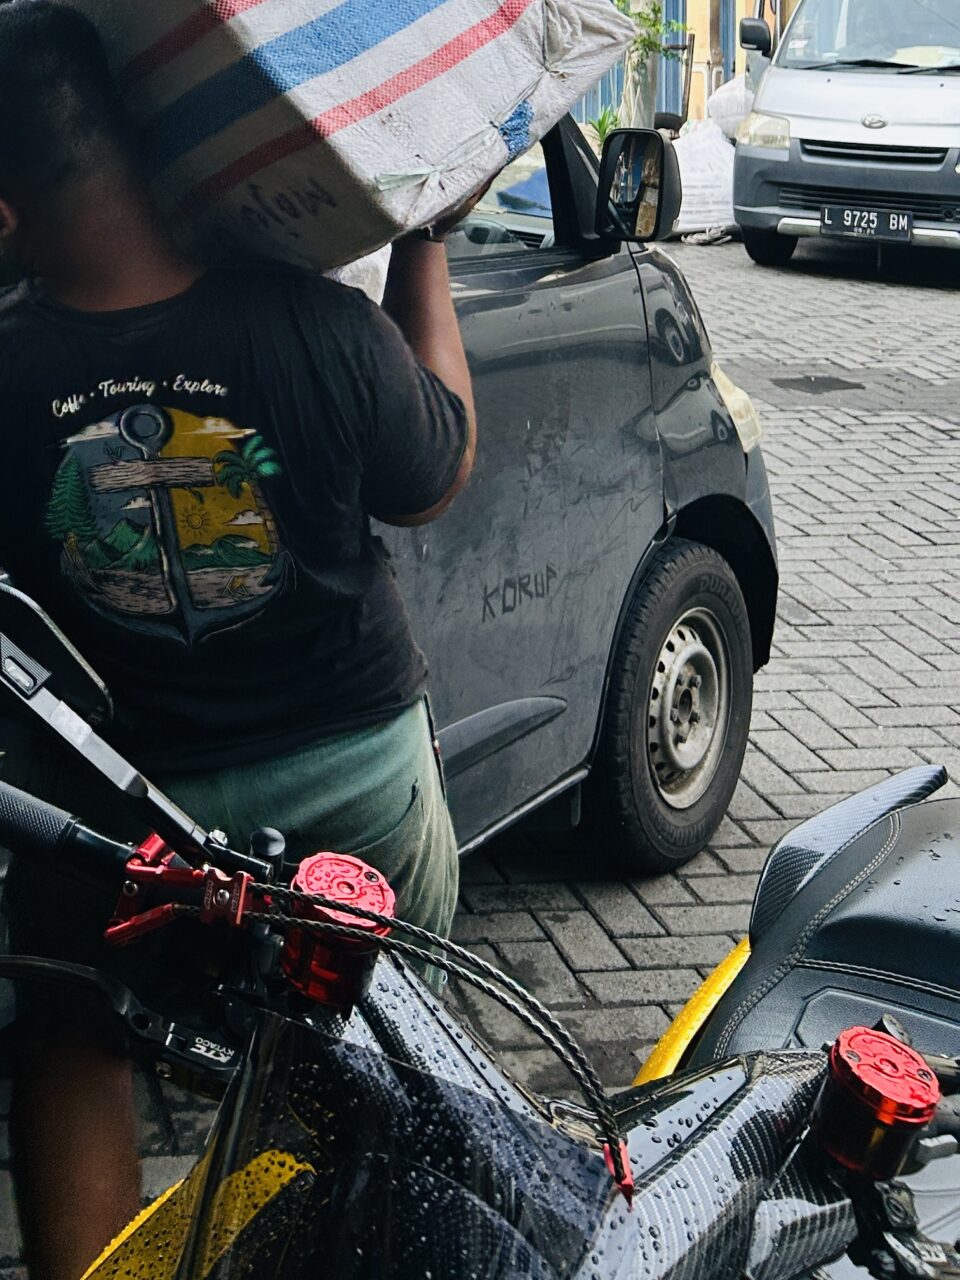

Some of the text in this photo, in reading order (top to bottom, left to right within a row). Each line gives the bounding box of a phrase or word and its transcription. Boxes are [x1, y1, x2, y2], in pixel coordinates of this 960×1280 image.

[824, 208, 833, 225] L
[843, 210, 879, 229] 9725
[889, 213, 909, 231] BM
[98, 376, 156, 397] Touring
[173, 374, 230, 397] Explore
[195, 1037, 235, 1057] KYTACO
